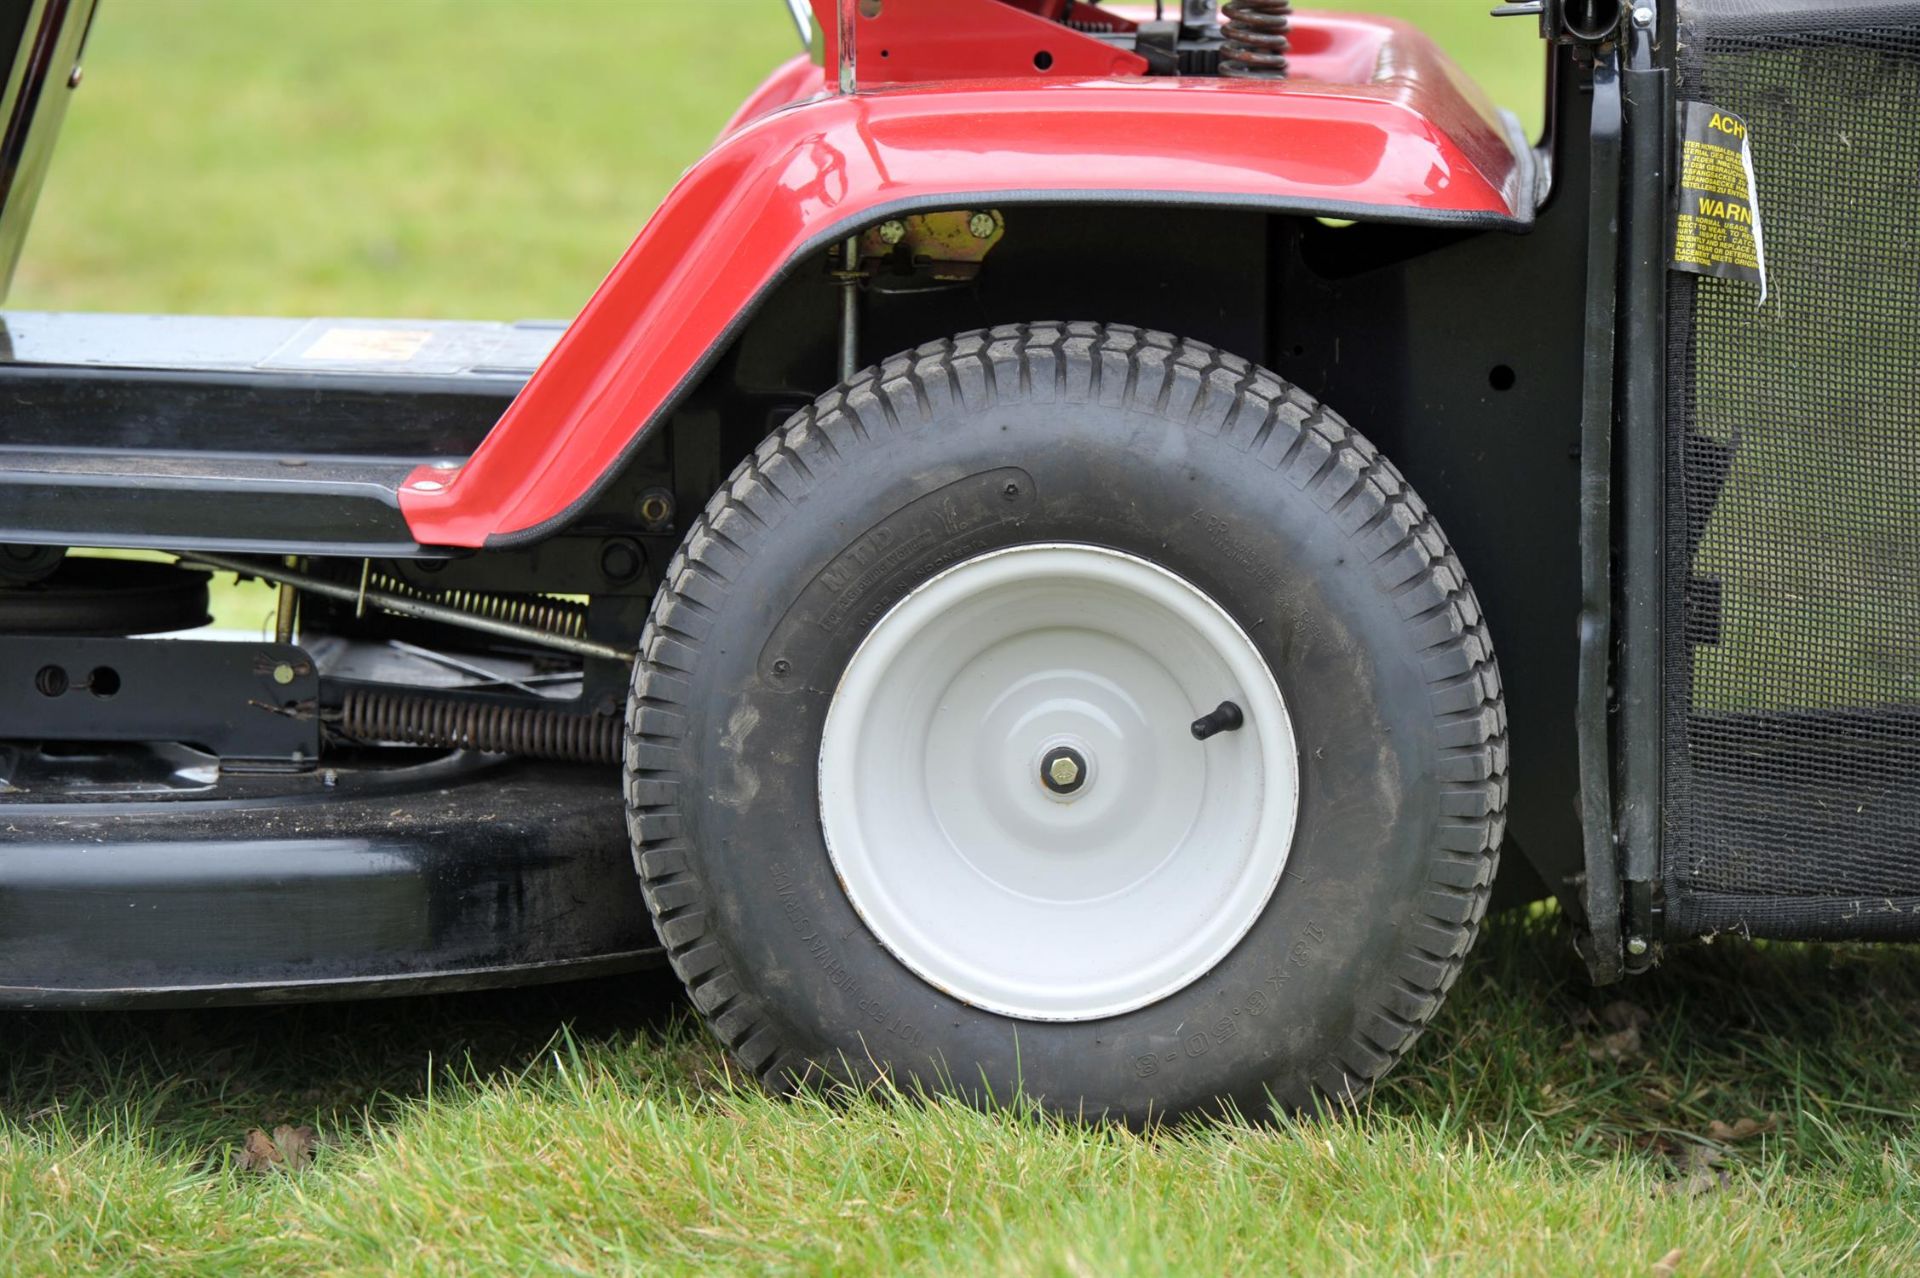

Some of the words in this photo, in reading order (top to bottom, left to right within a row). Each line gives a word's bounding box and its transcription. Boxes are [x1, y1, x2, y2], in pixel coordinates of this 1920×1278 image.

[1699, 197, 1752, 225] WARN
[1696, 216, 1721, 227] NORMAL
[1699, 231, 1727, 242] INSPECT
[1698, 244, 1713, 252] WEAR
[1720, 242, 1750, 253] REPLACE
[1712, 254, 1733, 263] MEETS
